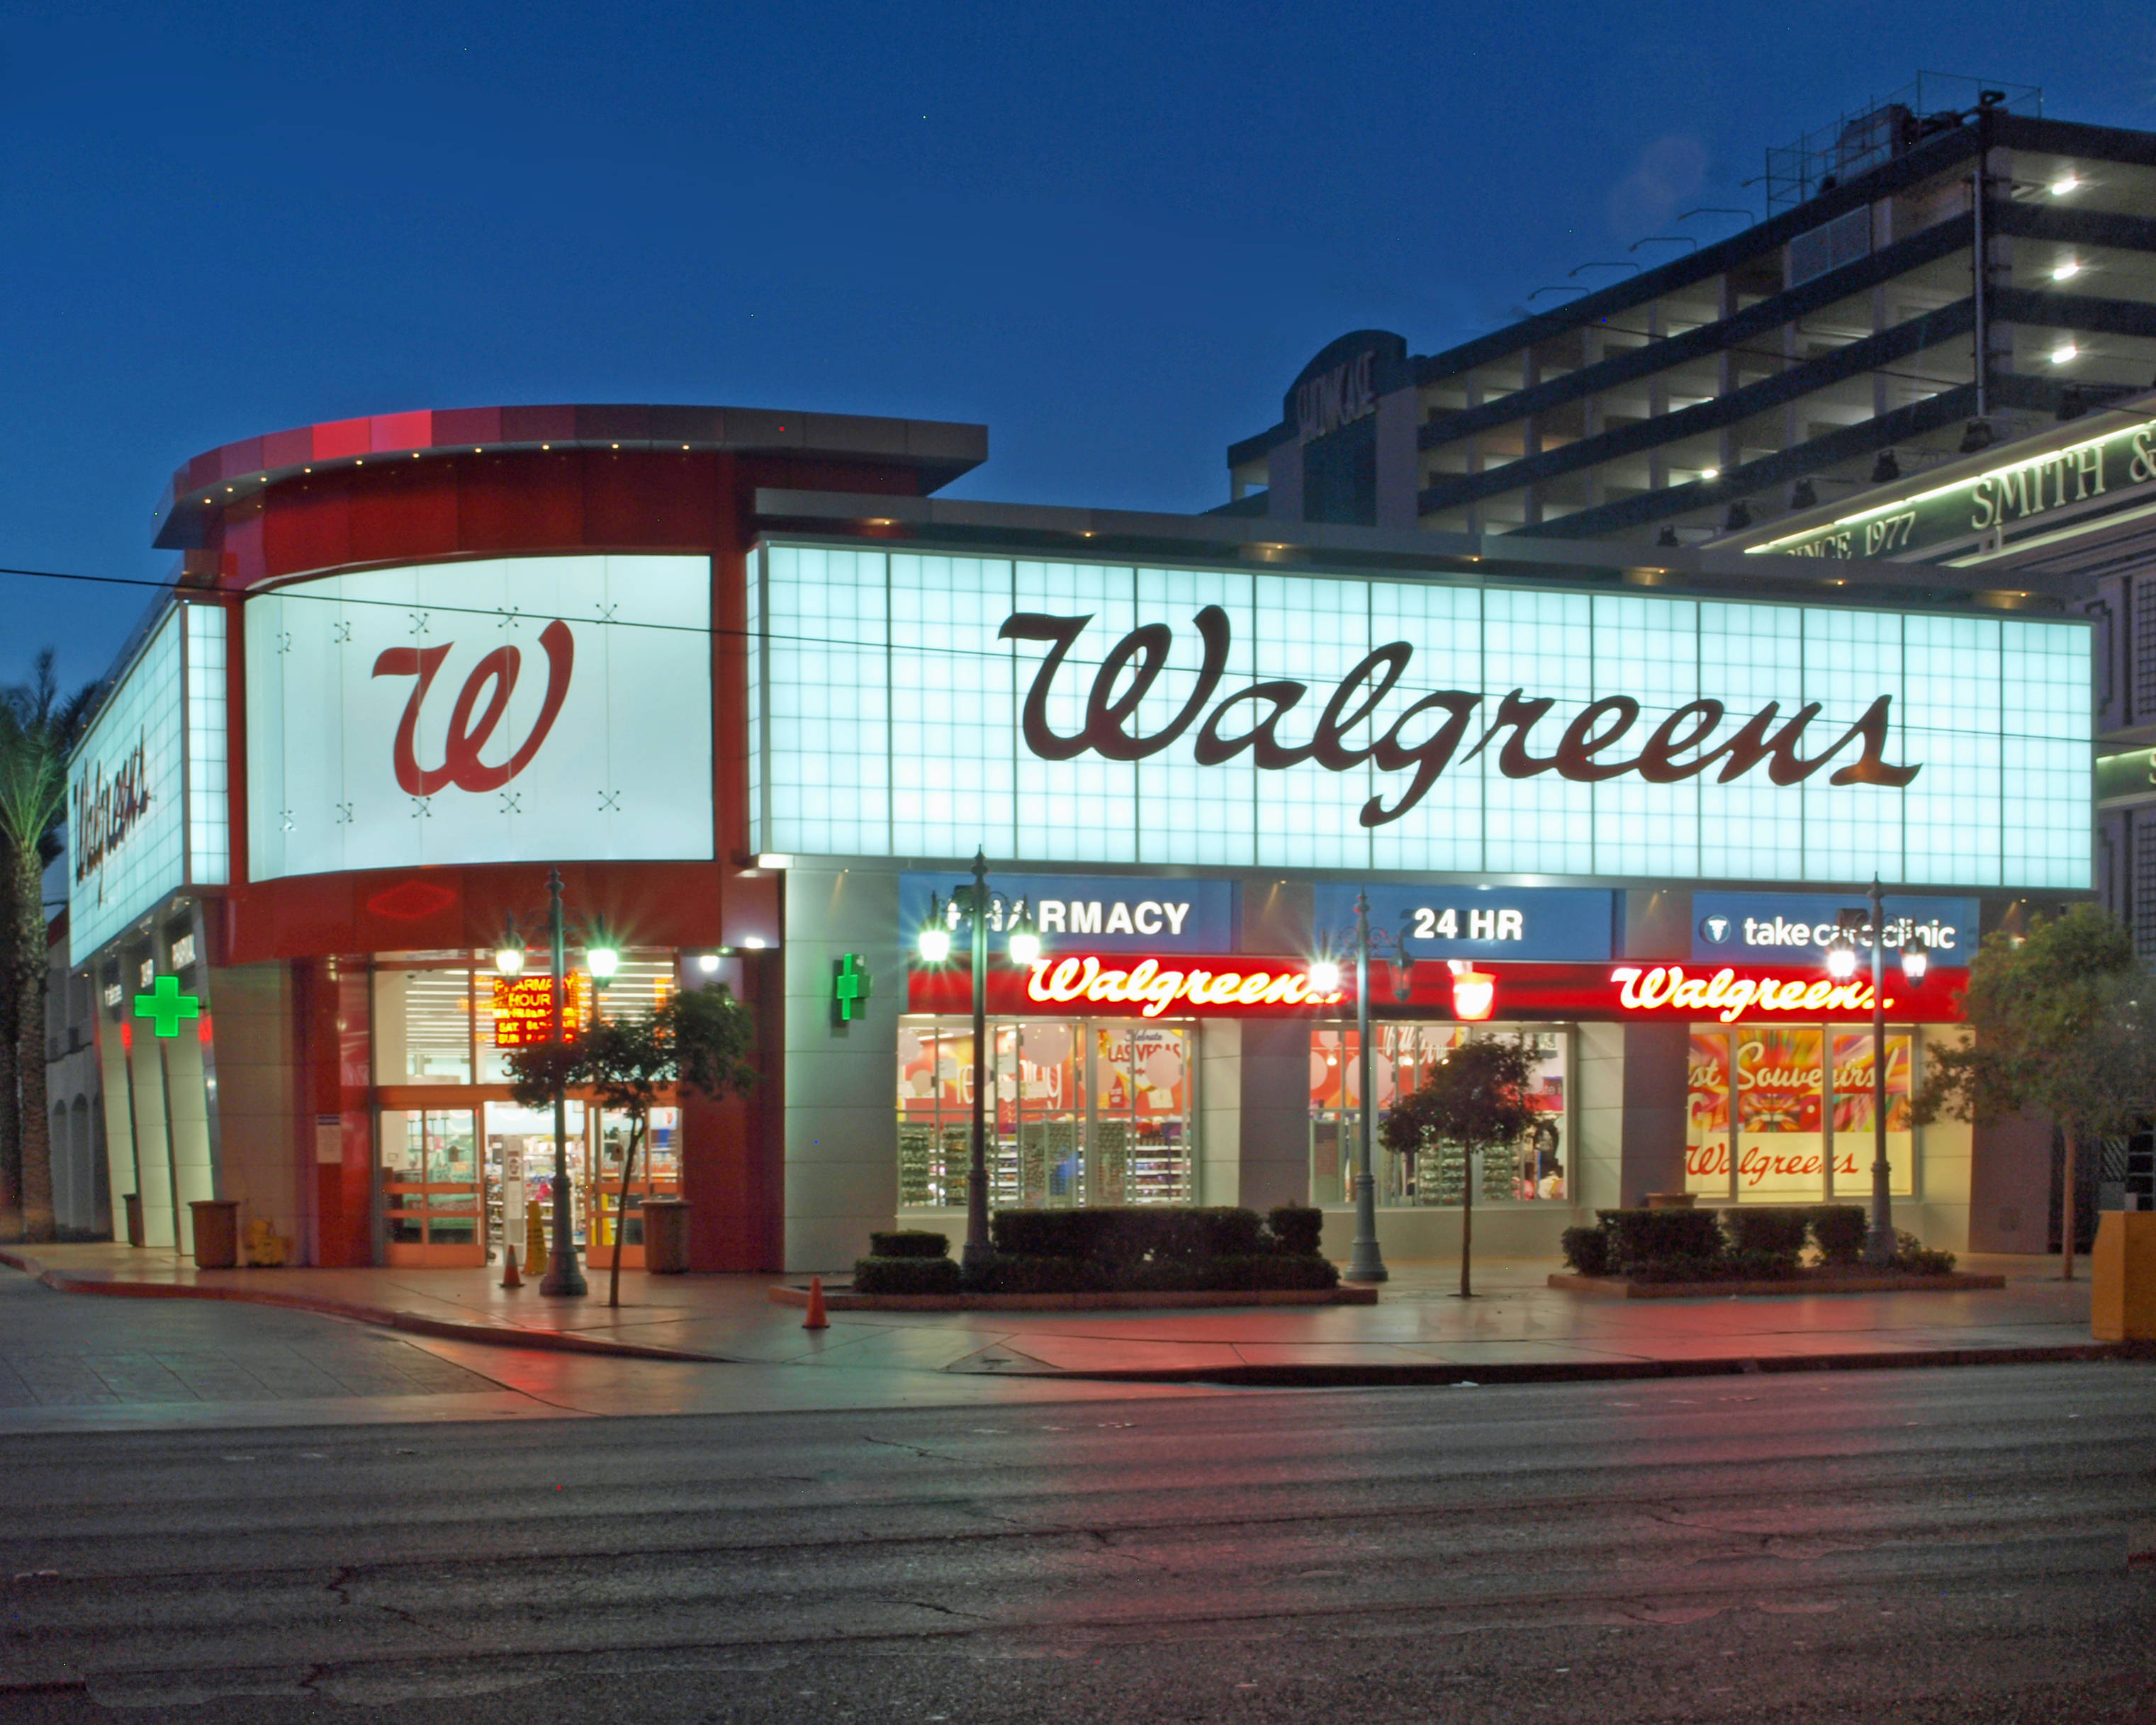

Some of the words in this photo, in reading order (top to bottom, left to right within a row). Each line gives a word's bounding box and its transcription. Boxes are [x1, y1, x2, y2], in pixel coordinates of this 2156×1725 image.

[1972, 444, 2106, 530] SMITH
[1786, 532, 1852, 560] NCE
[1865, 511, 1916, 556] 1977
[371, 619, 574, 797] W
[998, 605, 1922, 828] Walgreens
[1414, 907, 1458, 939] 24
[1470, 909, 1523, 940] HR
[1745, 916, 1810, 945] take
[1882, 918, 1955, 949] clinic
[494, 978, 575, 992] PARMAY
[508, 993, 552, 1006] HOUR
[1028, 957, 1342, 1018] Walgreen
[1108, 1045, 1132, 1062] LAS
[1135, 1043, 1181, 1062] VES
[1688, 1057, 1721, 1088] st
